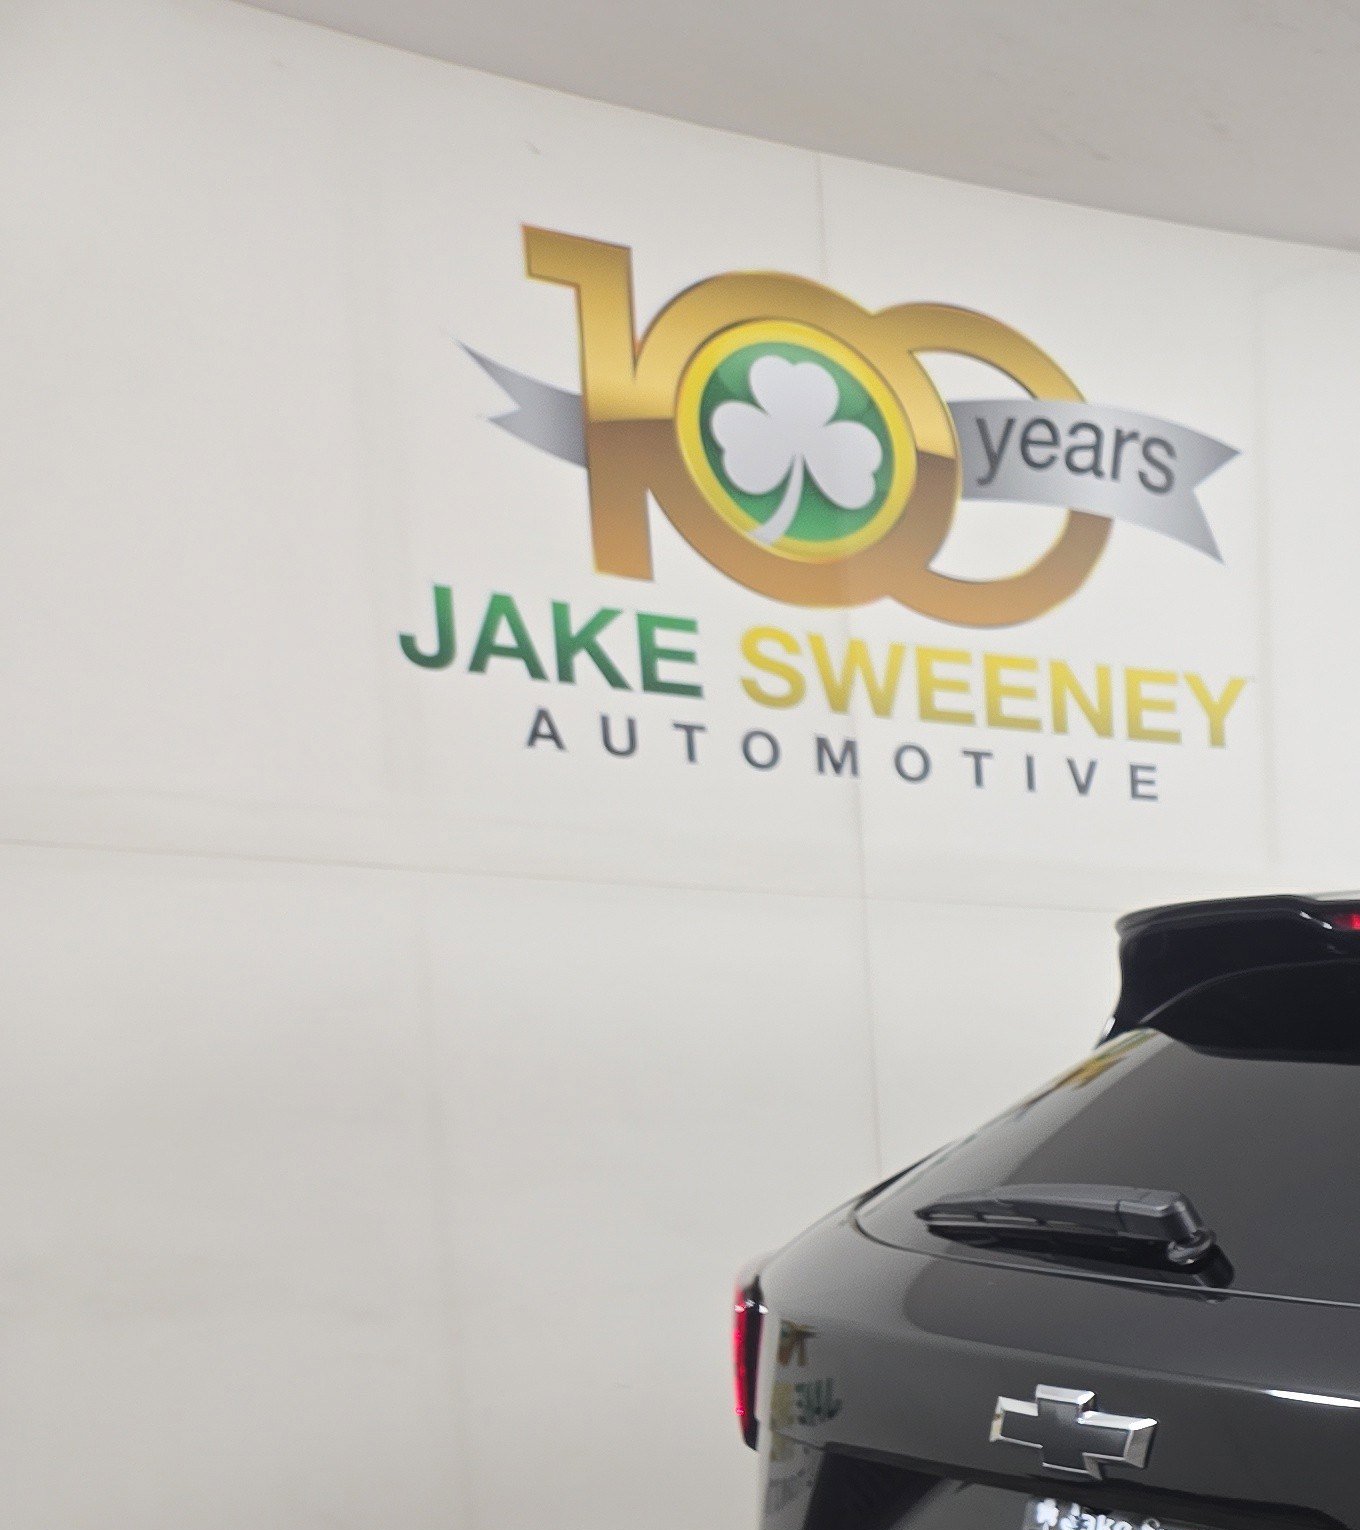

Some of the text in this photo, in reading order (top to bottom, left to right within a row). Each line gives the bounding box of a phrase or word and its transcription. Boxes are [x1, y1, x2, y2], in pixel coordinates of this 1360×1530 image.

[521, 223, 1115, 630] 100
[974, 416, 1178, 496] years
[397, 583, 1248, 749] JAKE SWEENEY
[525, 707, 1161, 802] AUTOMOTIVE
